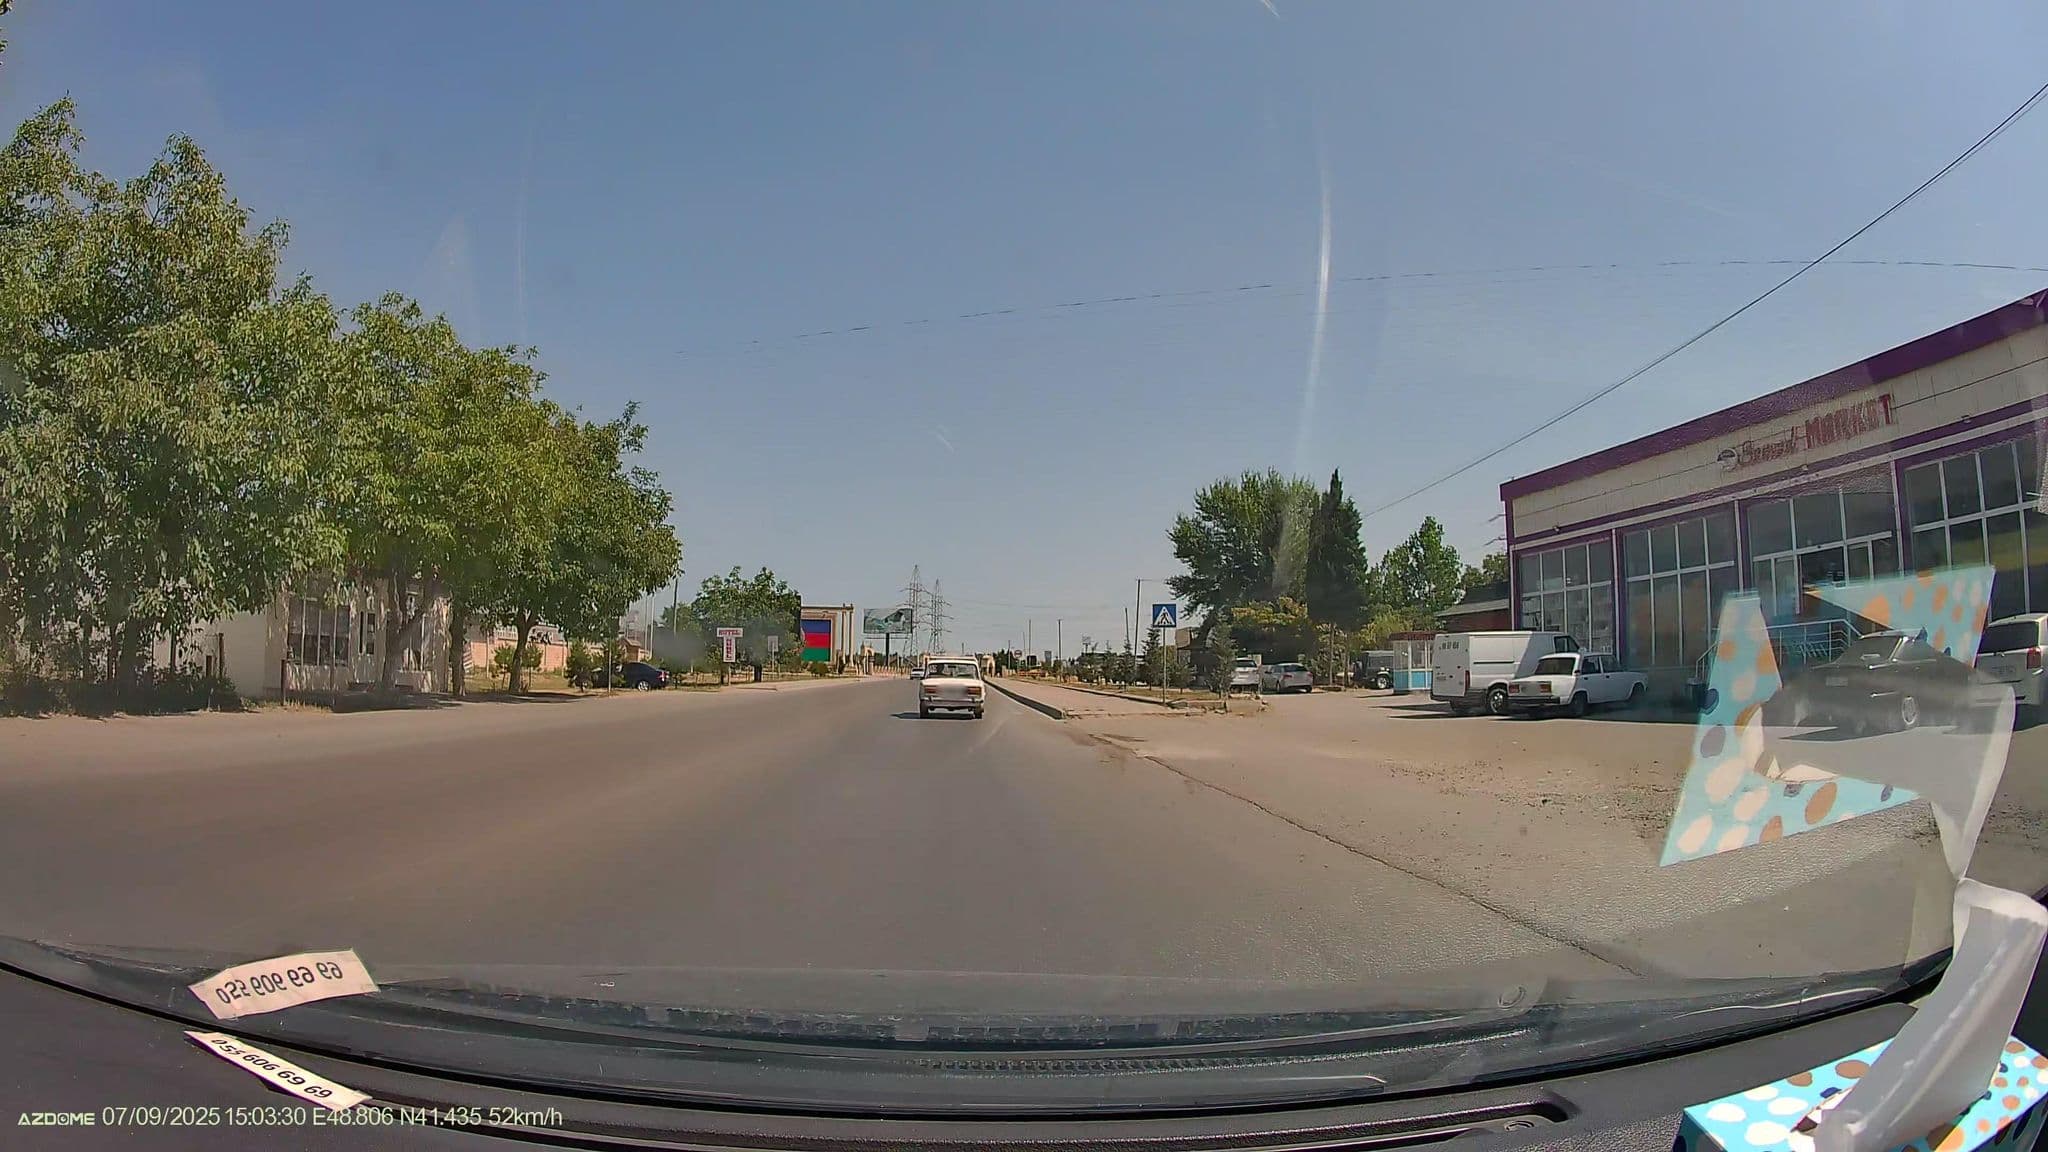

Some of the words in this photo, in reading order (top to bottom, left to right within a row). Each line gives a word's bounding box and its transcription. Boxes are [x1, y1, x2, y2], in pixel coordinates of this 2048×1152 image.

[1805, 393, 1892, 448] MARKET
[211, 1038, 242, 1056] 055
[242, 1051, 280, 1071] 606
[277, 1070, 306, 1085] 69
[303, 1085, 333, 1098] 69
